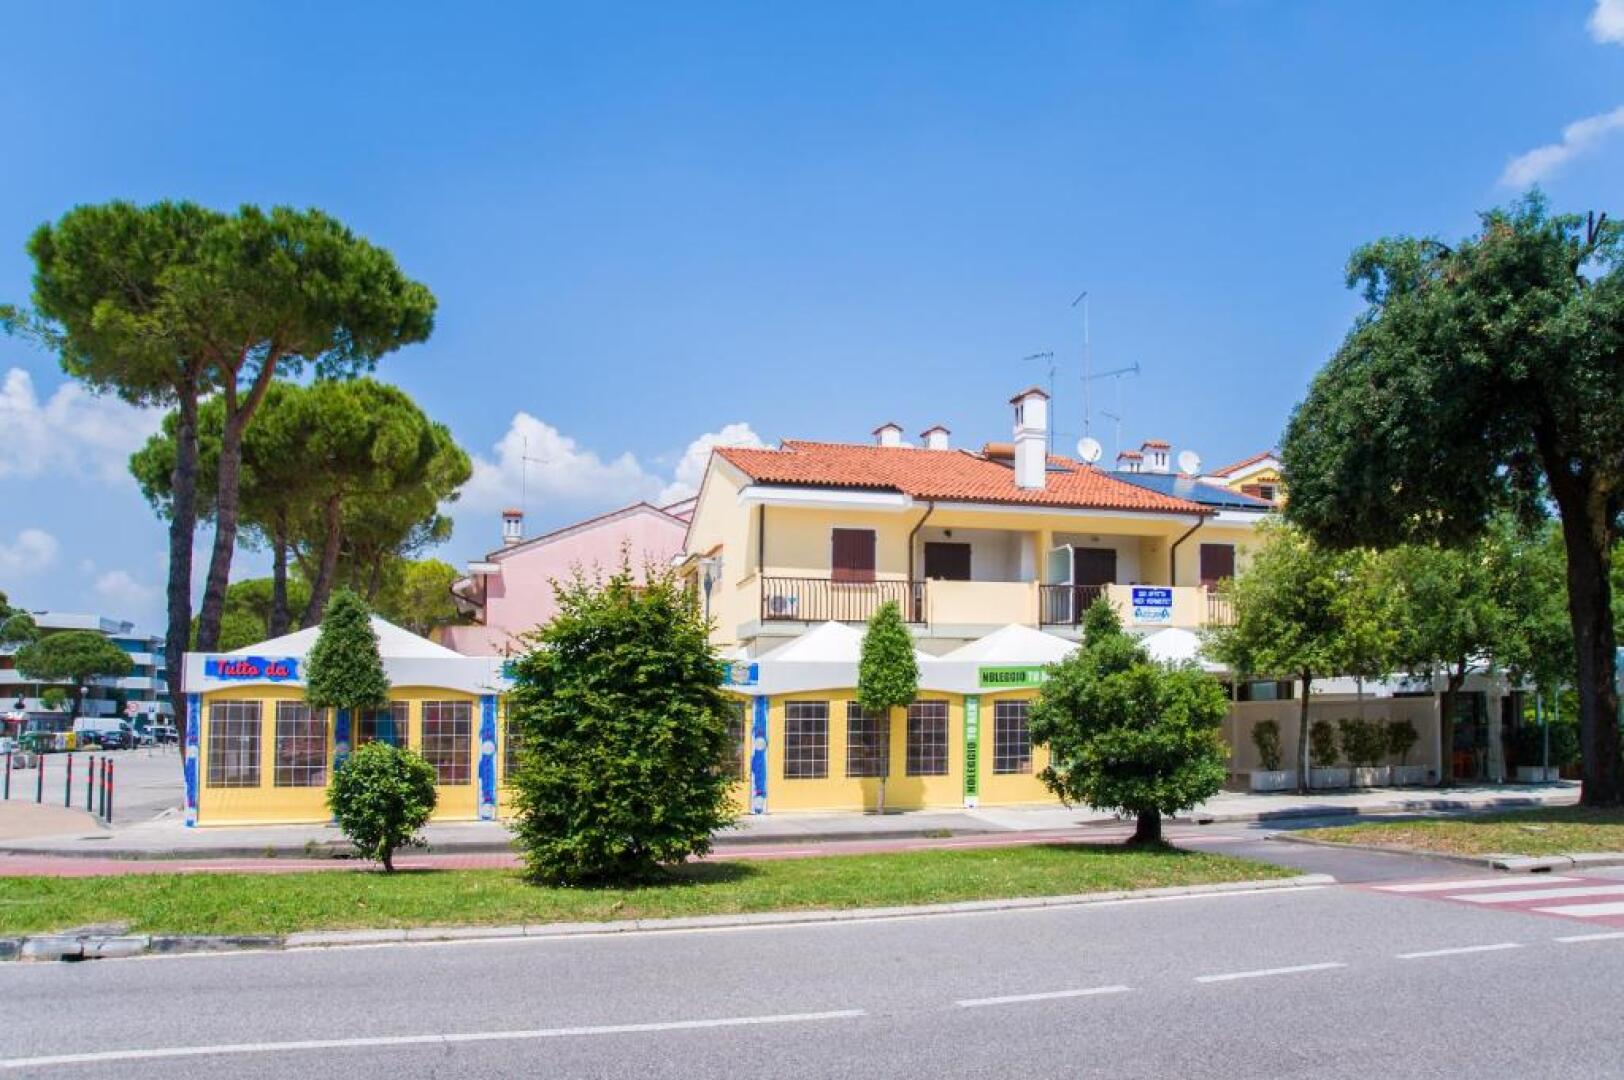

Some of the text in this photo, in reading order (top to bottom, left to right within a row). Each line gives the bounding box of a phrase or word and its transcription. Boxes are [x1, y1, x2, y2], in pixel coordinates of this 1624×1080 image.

[265, 661, 289, 677] da
[982, 671, 1025, 683] NOLEGGIO
[966, 741, 978, 794] NOLEGGIO
